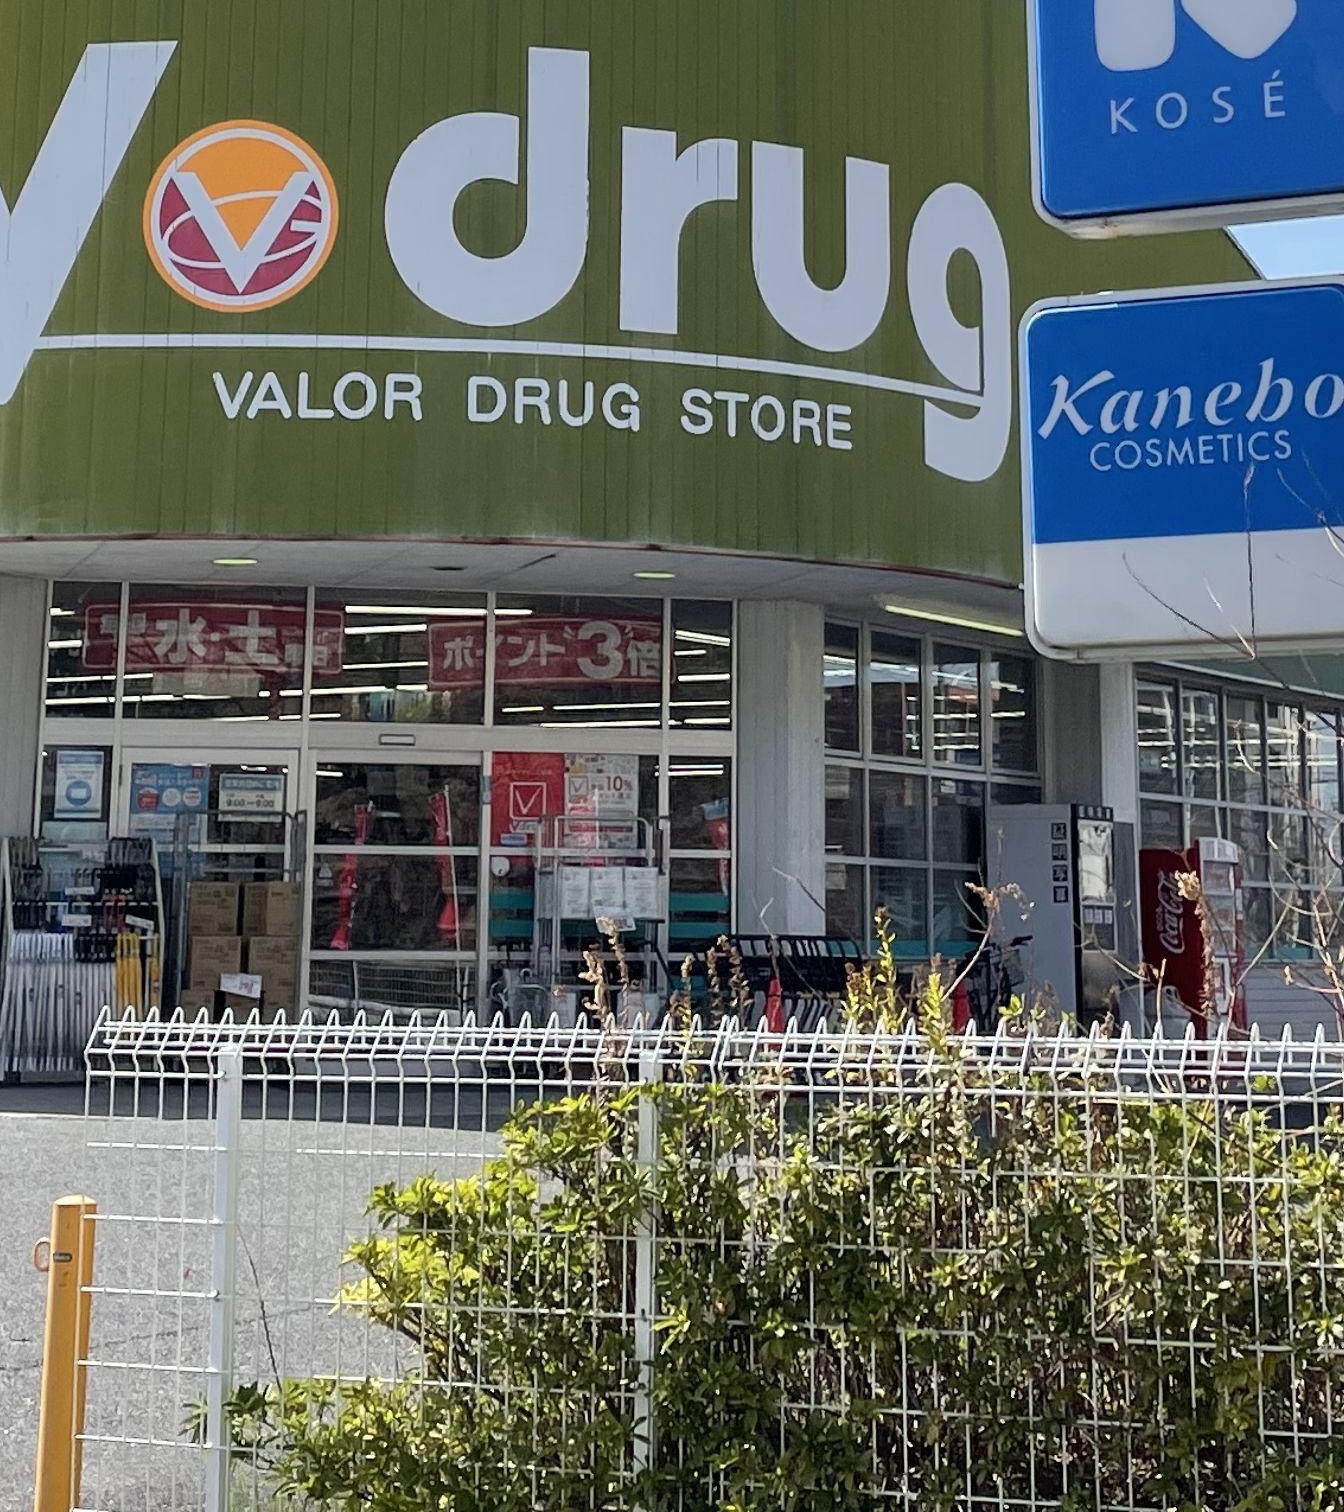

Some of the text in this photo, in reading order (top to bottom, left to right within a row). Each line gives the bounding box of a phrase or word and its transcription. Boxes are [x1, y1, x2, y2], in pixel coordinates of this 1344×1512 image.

[1110, 70, 1287, 134] KOSÉ
[213, 371, 854, 451] VALOR DRUG STORE
[1089, 429, 1292, 472] COSMETICS
